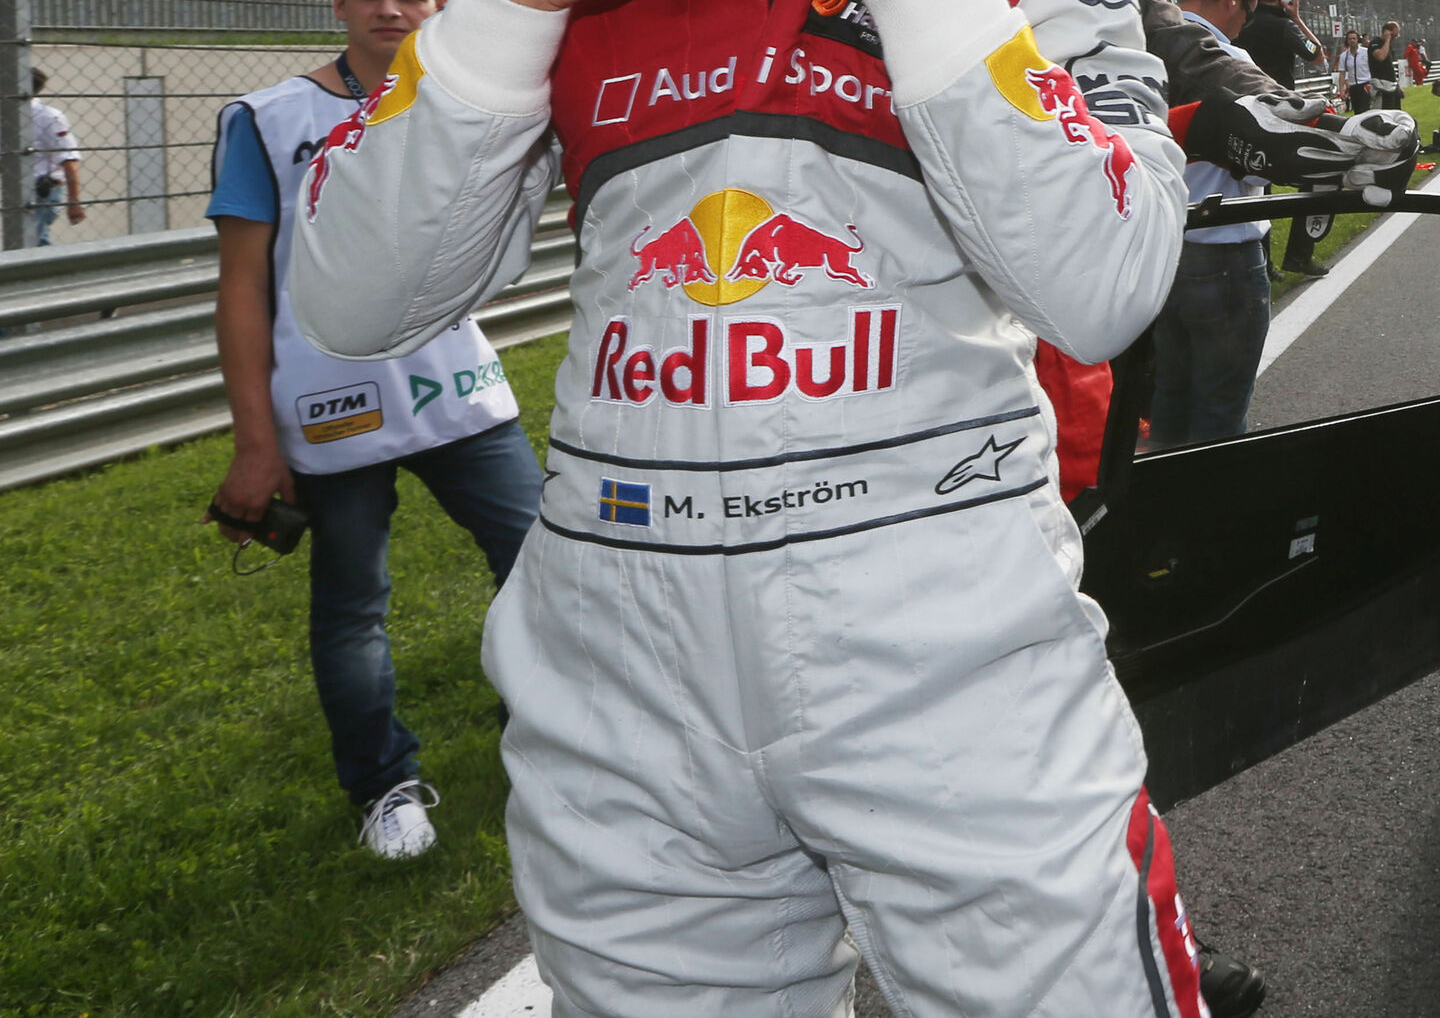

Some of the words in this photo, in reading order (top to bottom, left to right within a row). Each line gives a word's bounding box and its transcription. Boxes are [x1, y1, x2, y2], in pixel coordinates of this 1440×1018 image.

[591, 316, 710, 406] Red
[726, 307, 899, 403] Bull
[309, 392, 367, 419] DTM
[664, 495, 704, 520] M.
[724, 478, 868, 519] Ekström
